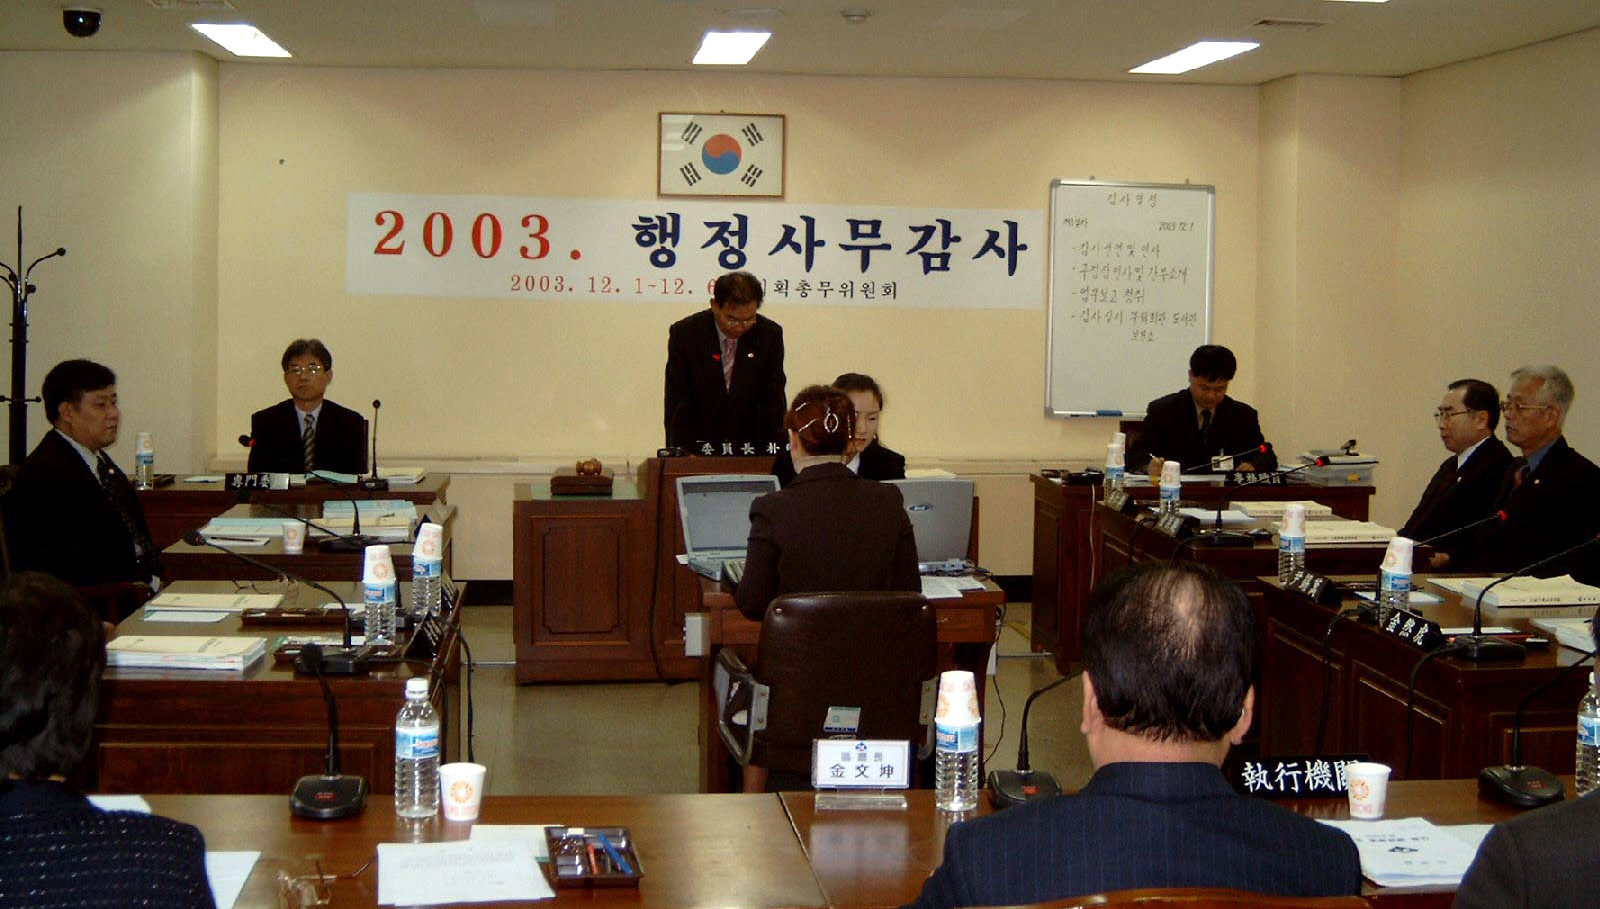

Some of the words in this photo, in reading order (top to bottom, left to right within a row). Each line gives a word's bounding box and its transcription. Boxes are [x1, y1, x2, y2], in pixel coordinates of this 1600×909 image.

[373, 210, 582, 260] 2003.
[631, 212, 1028, 277] 행정사무감사
[763, 278, 898, 300] 획총무위원회
[829, 763, 894, 779] 金文坤
